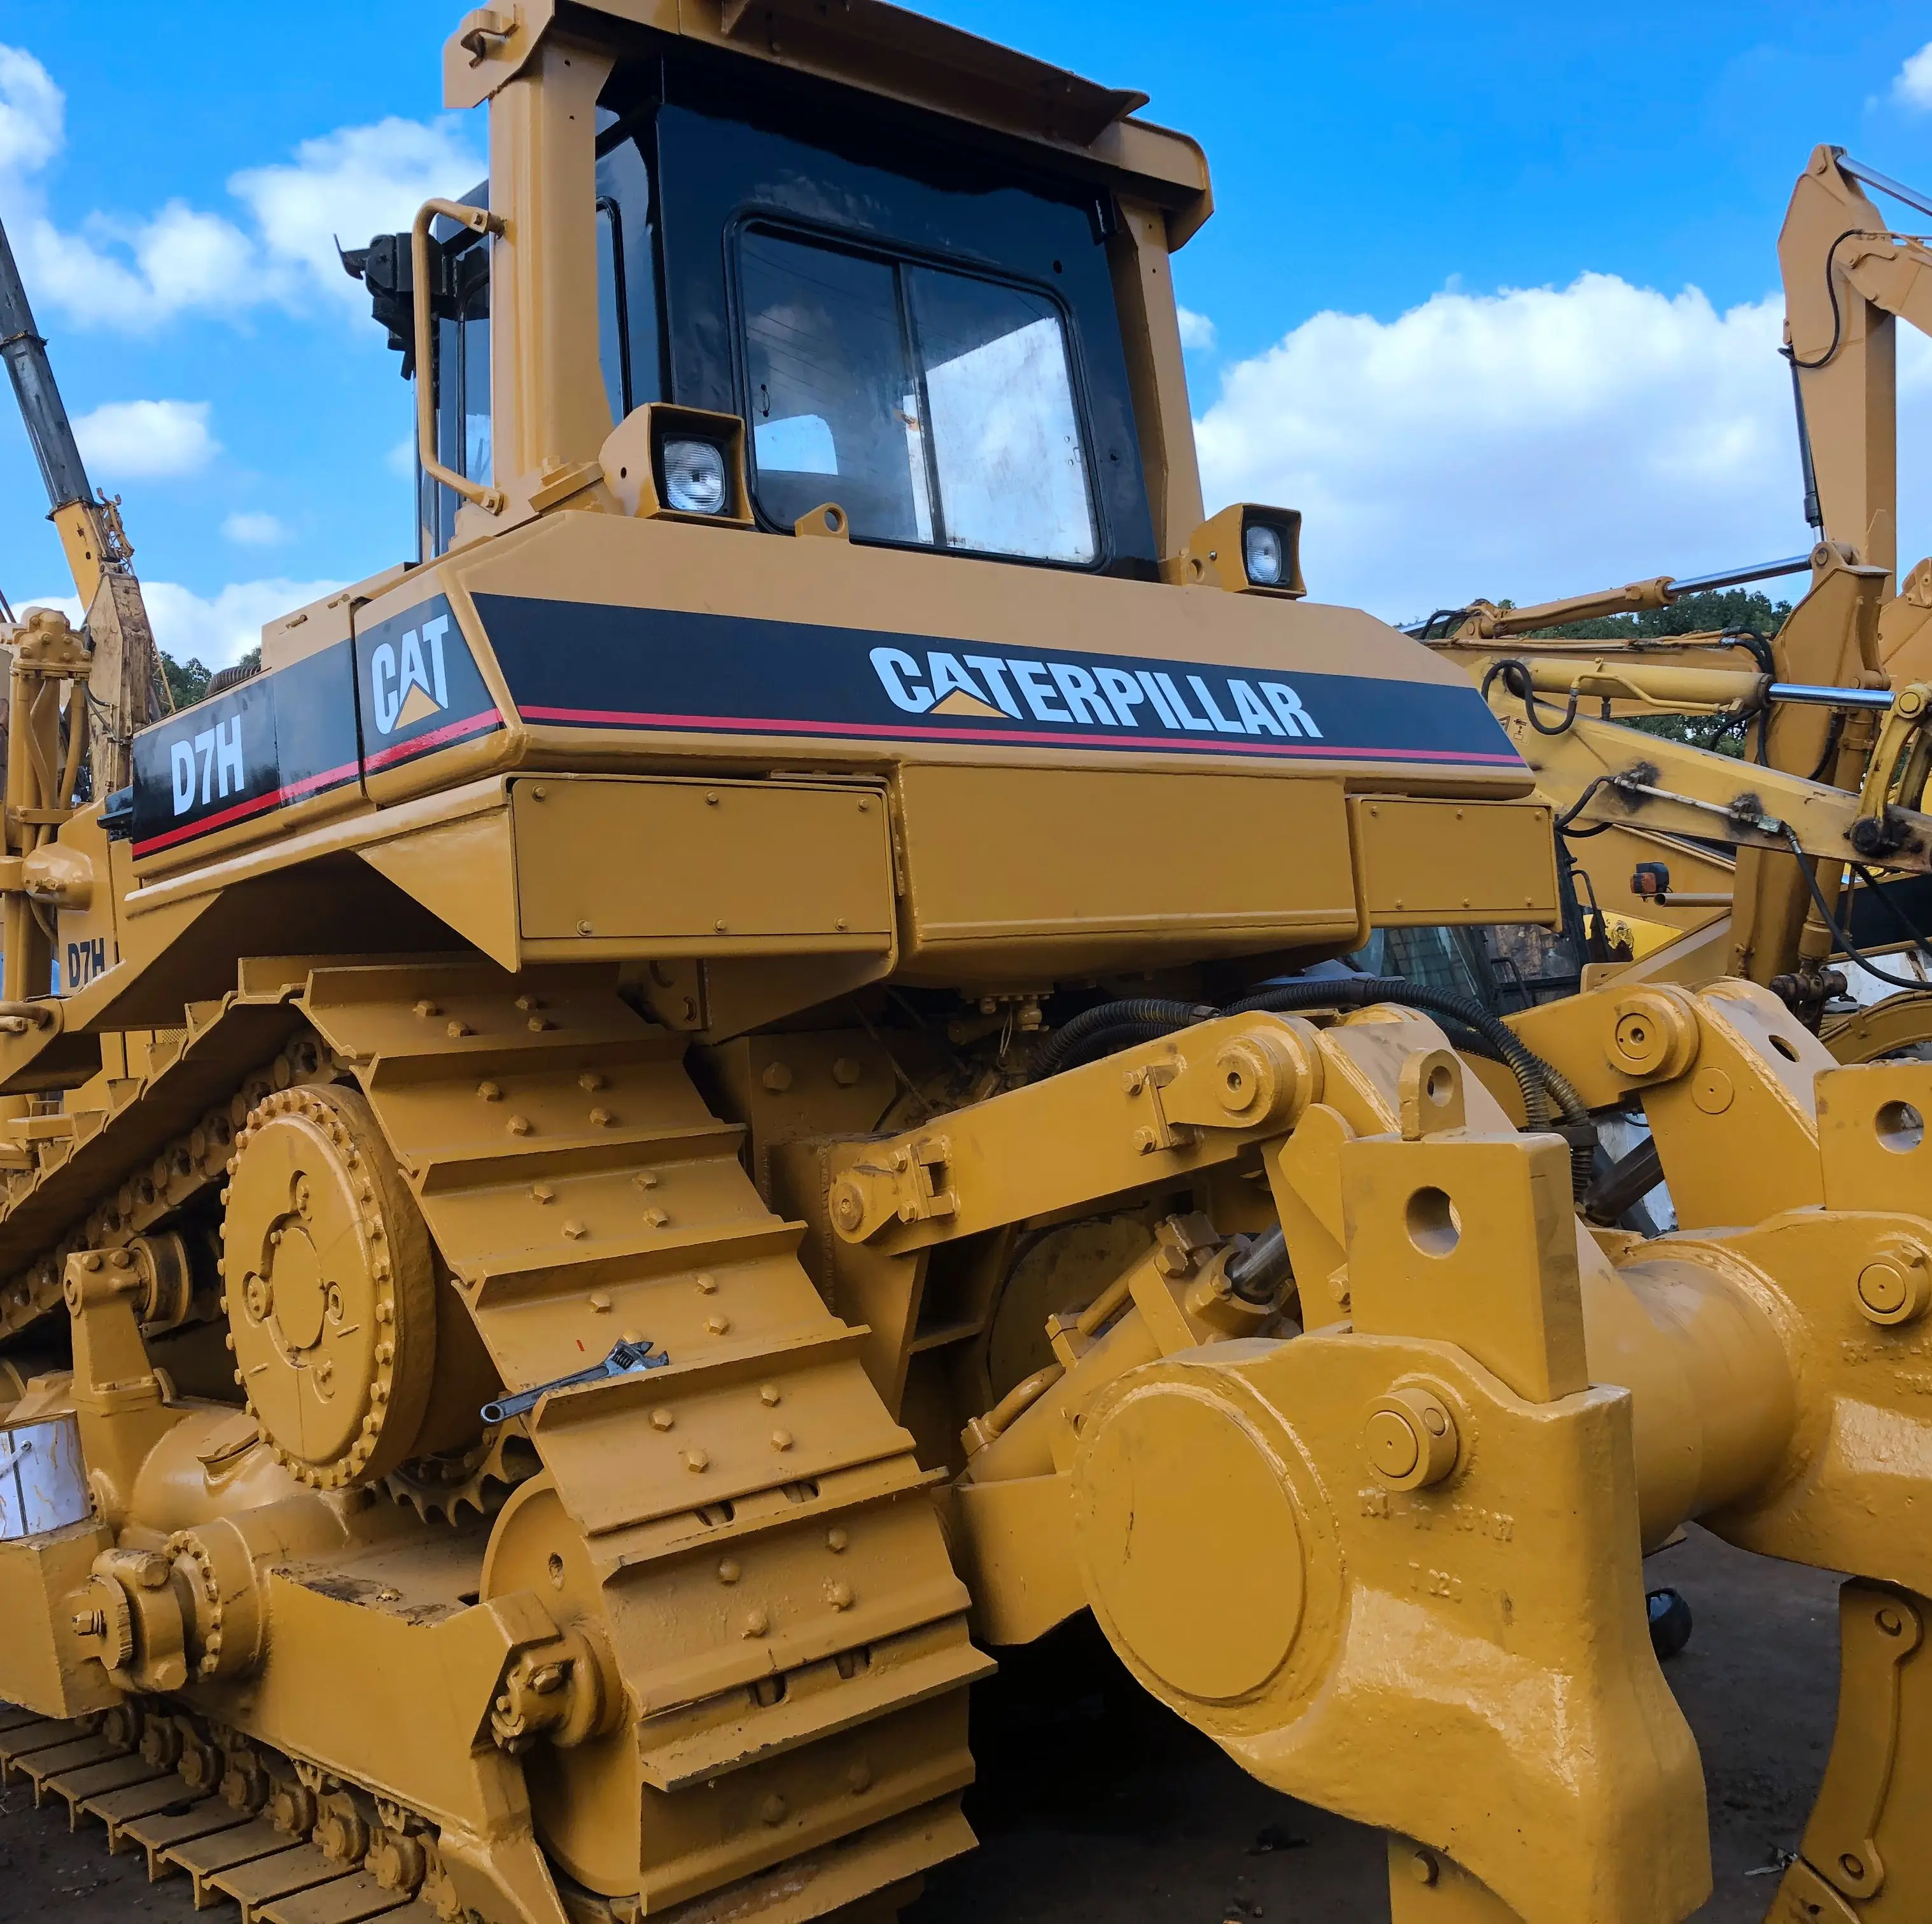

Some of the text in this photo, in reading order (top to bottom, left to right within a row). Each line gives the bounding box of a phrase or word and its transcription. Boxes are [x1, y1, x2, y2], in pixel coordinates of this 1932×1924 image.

[372, 614, 449, 735] CAT
[869, 647, 1323, 738] CATERPILLAR
[171, 715, 245, 816] D7H
[67, 937, 105, 988] D7H
